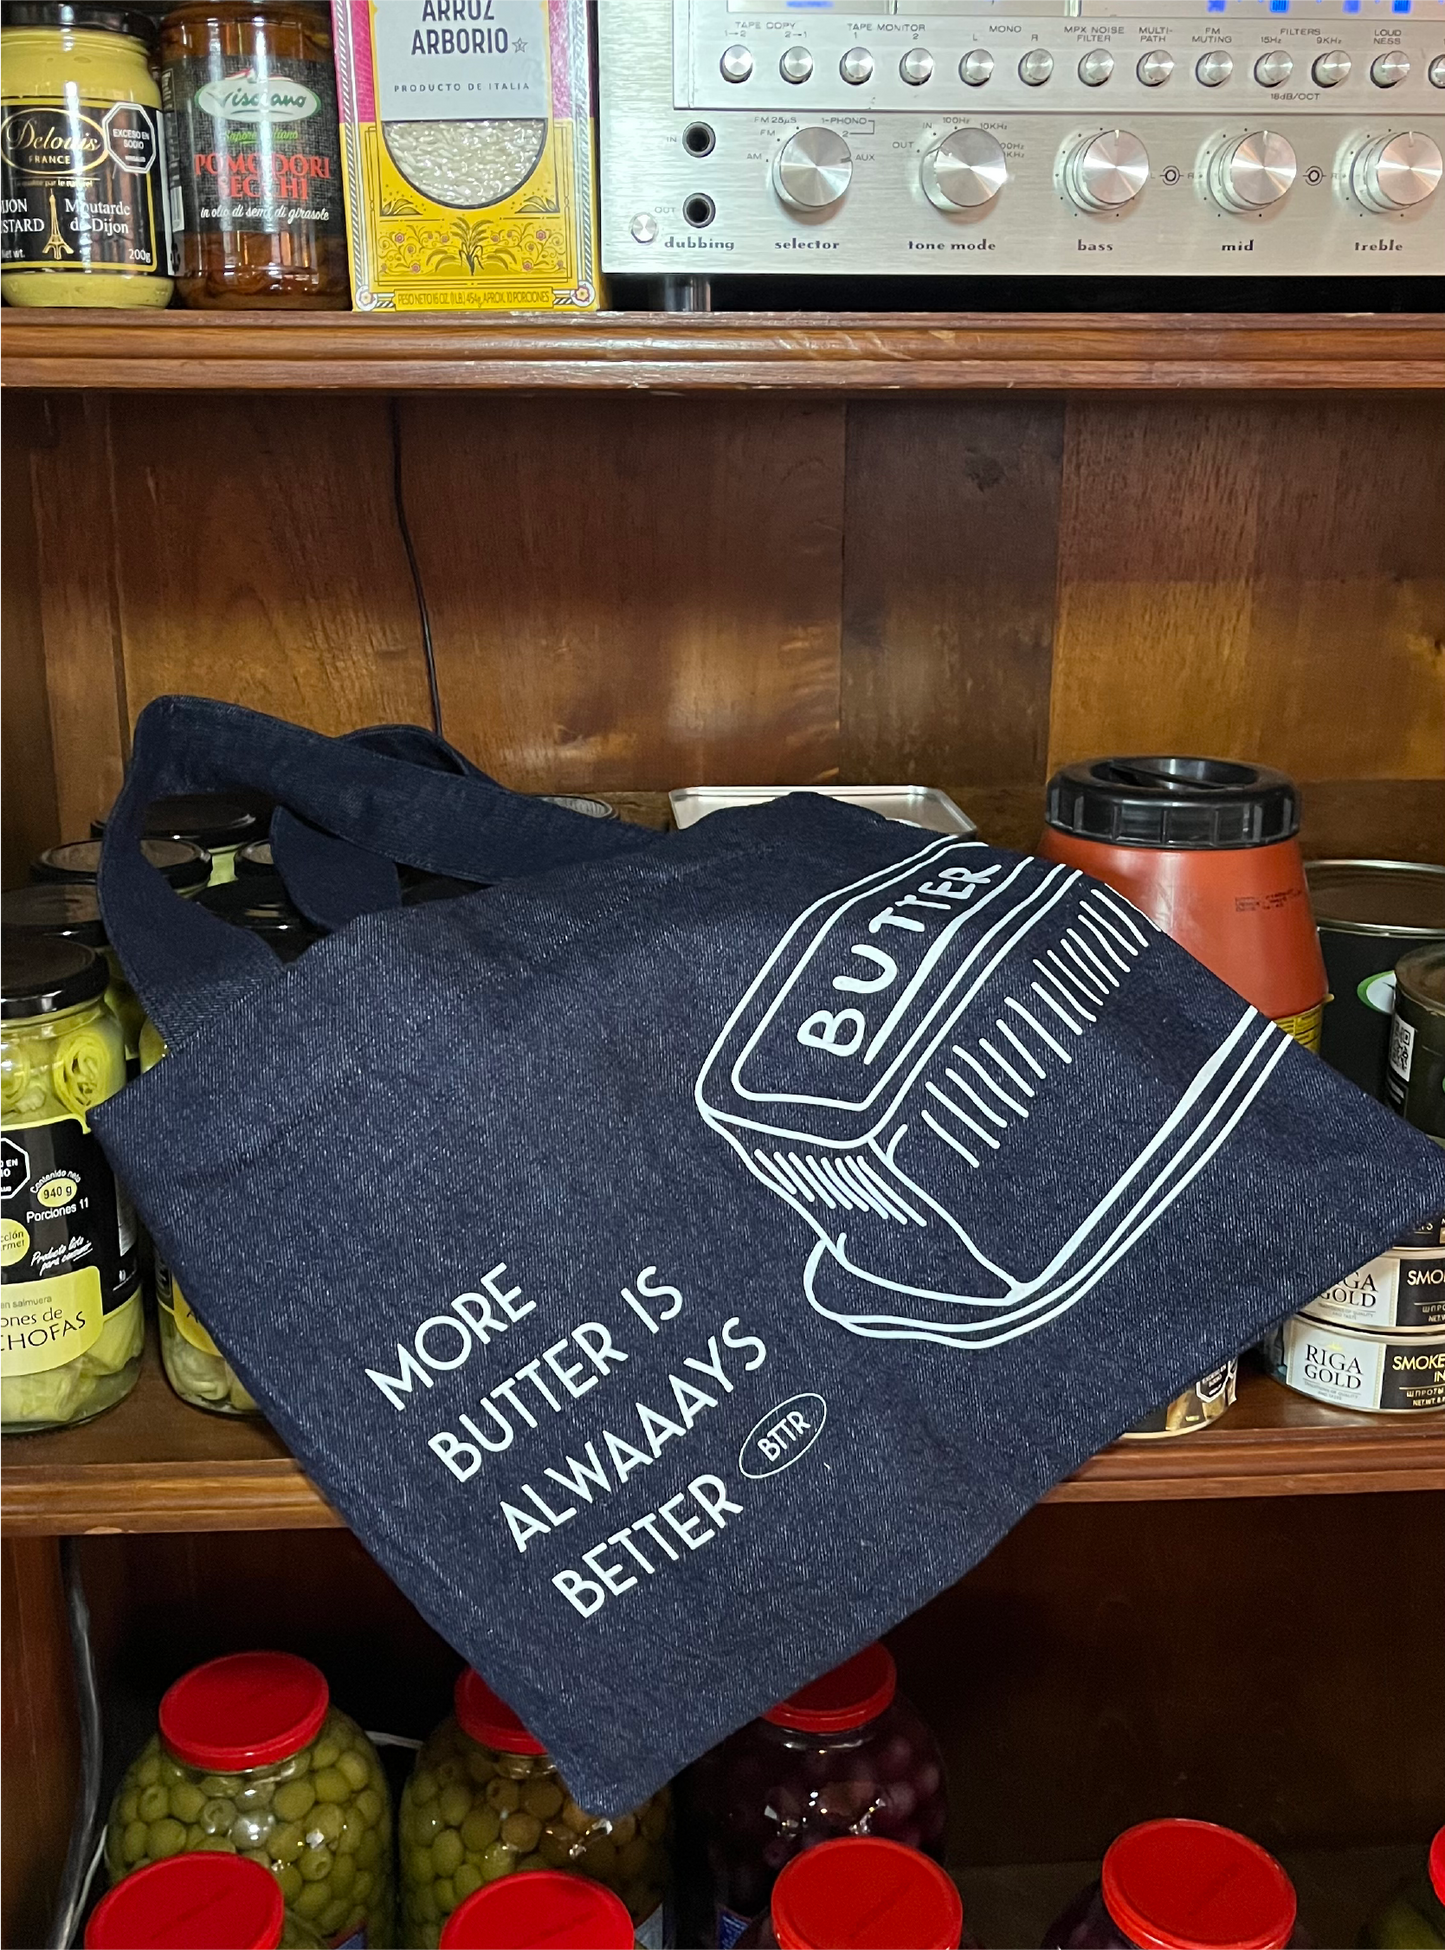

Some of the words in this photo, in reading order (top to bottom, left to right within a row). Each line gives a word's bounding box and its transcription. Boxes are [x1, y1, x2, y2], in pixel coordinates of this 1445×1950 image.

[422, 0, 495, 22] ARROZ
[735, 21, 761, 30] TAPE
[766, 22, 796, 30] COPY
[847, 23, 873, 31] TAPE
[877, 23, 926, 32] MONITOR
[989, 25, 1022, 33] MONO
[1064, 26, 1087, 34] MPX
[1091, 26, 1125, 35] NOISE
[1138, 26, 1173, 35] MULTI-
[1204, 27, 1221, 35] FM
[972, 34, 978, 42] L
[1031, 34, 1039, 42] R
[1280, 28, 1321, 36] FILTERS
[1374, 29, 1402, 37] LOUD
[411, 28, 508, 55] ARBORIO
[1077, 34, 1111, 43] FILTER
[1140, 34, 1166, 43] PATH
[1192, 35, 1232, 44] MUTING
[1261, 36, 1282, 44] 15Hz
[1316, 37, 1342, 45] 9KHz
[1373, 37, 1401, 45] NESS
[394, 83, 461, 93] PRODUCTO
[468, 83, 482, 91] DE
[489, 82, 530, 91] ITALIA
[1270, 92, 1320, 101] 18dB/OCT
[980, 122, 1008, 130] 10KHz
[760, 129, 775, 137] FM
[892, 141, 914, 149] OUT
[29, 155, 71, 165] FRANCE
[855, 153, 875, 161] AUX
[194, 152, 332, 179] POMODORI
[0, 198, 28, 214] IJON
[654, 206, 676, 214] OUT
[201, 207, 211, 218] in
[232, 204, 245, 218] di
[275, 204, 287, 218] di
[288, 207, 329, 225] girasole
[0, 218, 45, 234] STARD
[92, 218, 129, 236] Dijon
[664, 236, 735, 252] dubbing
[774, 237, 840, 251] selector
[908, 239, 945, 251] tone
[950, 239, 996, 251] mode
[1077, 239, 1114, 252] bass
[1221, 239, 1255, 252] mid
[1354, 240, 1403, 252] treble
[129, 248, 151, 263] 200g
[797, 864, 1002, 1057] BUTTER
[30, 1169, 66, 1194] Contenido
[67, 1170, 81, 1184] neto
[43, 1186, 63, 1200] 940
[66, 1186, 72, 1197] g
[26, 1203, 77, 1223] Porciones
[79, 1197, 89, 1210] 11
[0, 1239, 25, 1251] rmet
[12, 1296, 52, 1308] salmuera
[42, 1307, 63, 1322] de
[364, 1262, 537, 1412] MORE
[1305, 1343, 1364, 1376] RIGA
[428, 1321, 629, 1483] BUTTER
[621, 1265, 684, 1334] IS
[1304, 1363, 1362, 1390] GOLD
[1406, 1387, 1444, 1398] ШПРОТЫ
[499, 1316, 767, 1553] ALWAAAYS
[757, 1410, 812, 1463] BTTR
[551, 1473, 744, 1619] BETTER
